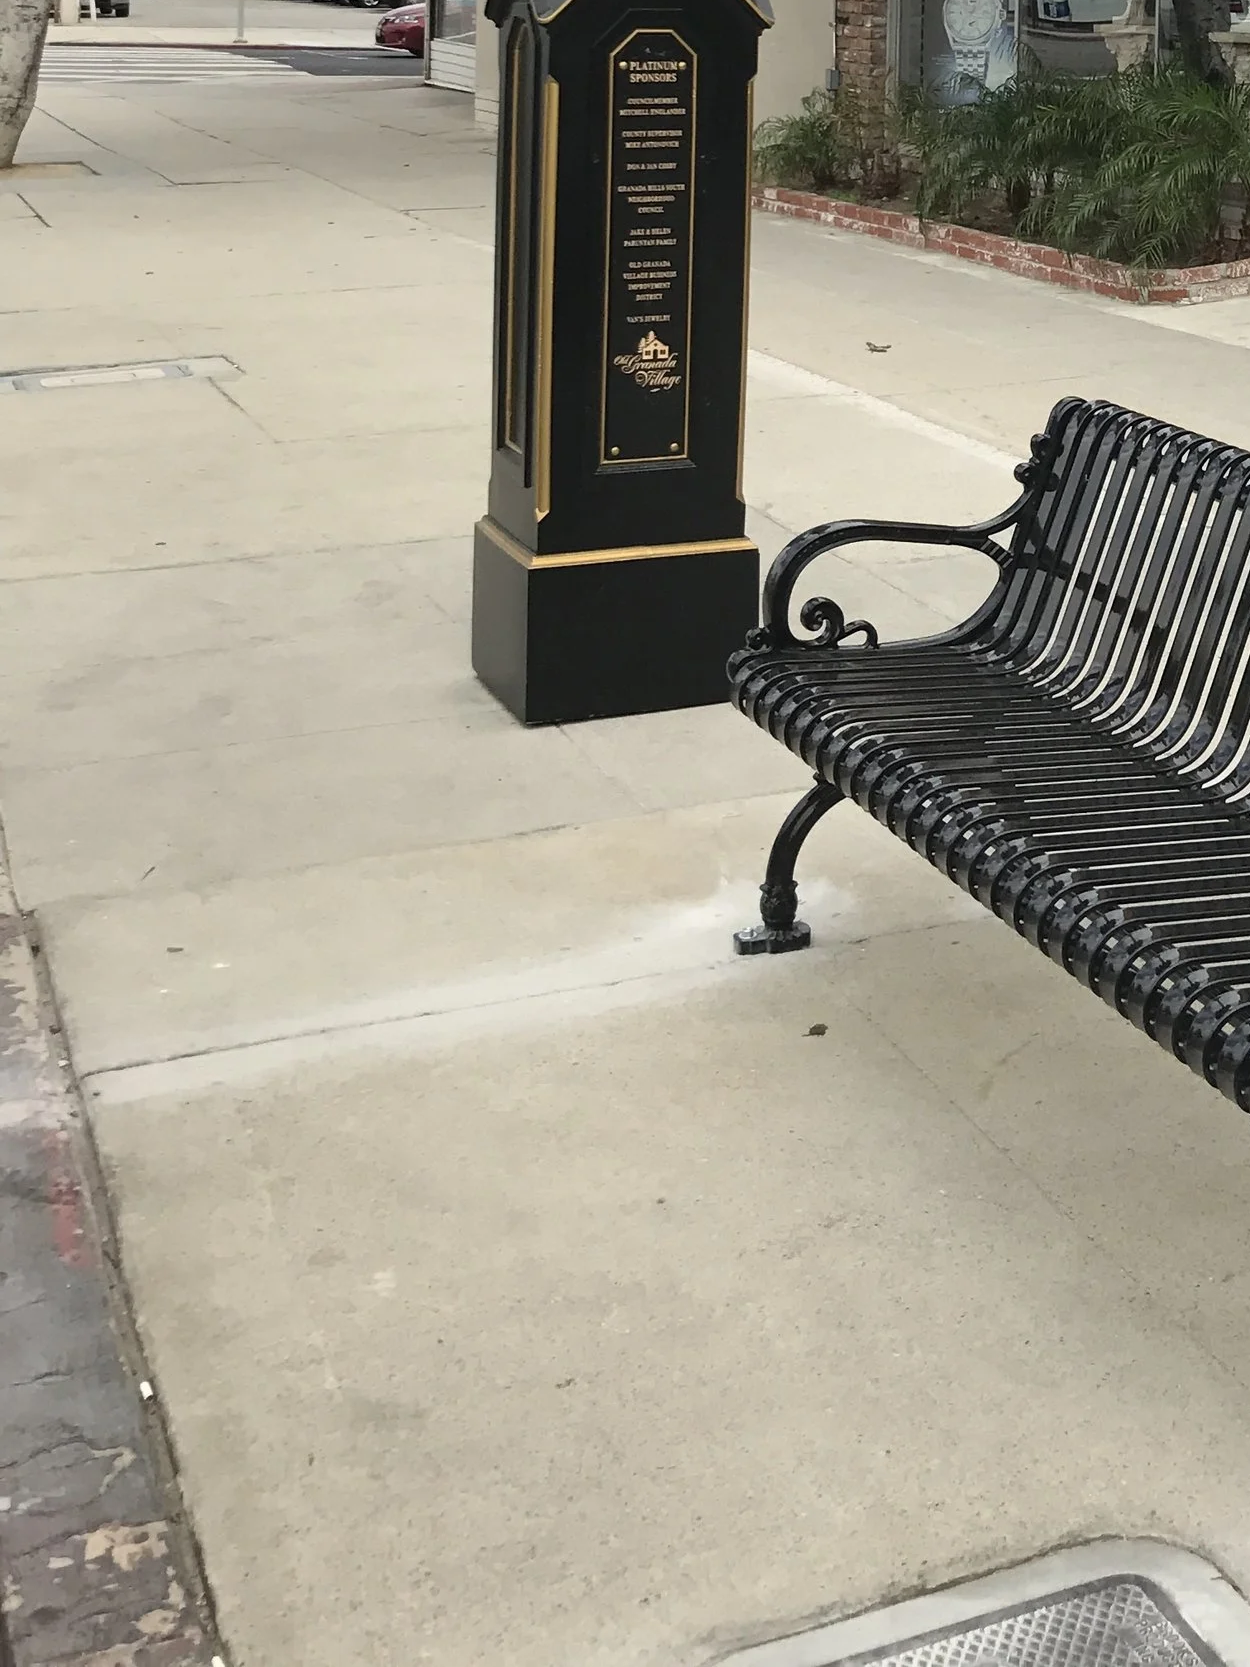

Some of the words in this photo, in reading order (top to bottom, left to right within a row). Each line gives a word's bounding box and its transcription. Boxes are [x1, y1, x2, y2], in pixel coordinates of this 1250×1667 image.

[629, 61, 678, 71] PLATINUM
[629, 73, 678, 83] SPONSORS
[621, 352, 678, 374] Granada
[635, 369, 681, 390] Village
